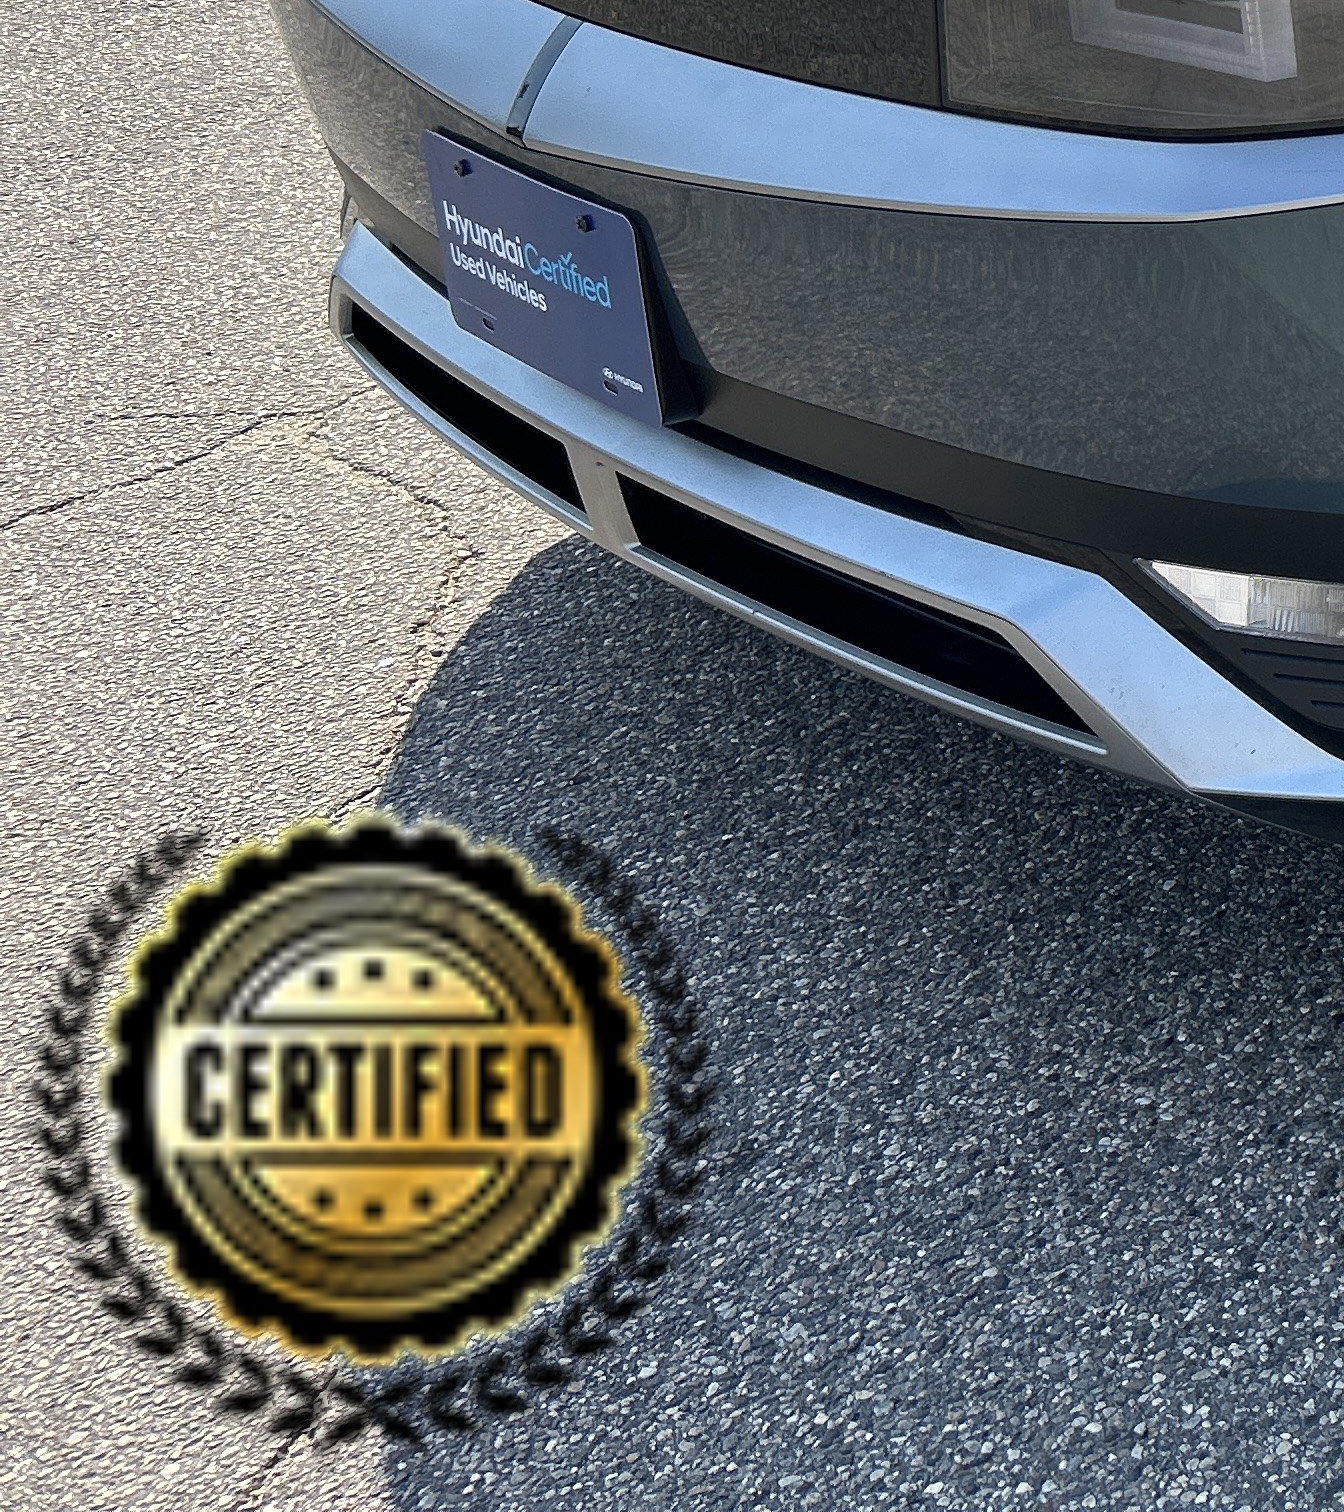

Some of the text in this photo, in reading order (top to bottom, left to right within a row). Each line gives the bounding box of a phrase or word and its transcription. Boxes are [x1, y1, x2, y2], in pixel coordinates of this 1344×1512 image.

[442, 199, 612, 310] Hyundai Certified
[449, 242, 487, 281] Used
[486, 259, 548, 312] Vehicles
